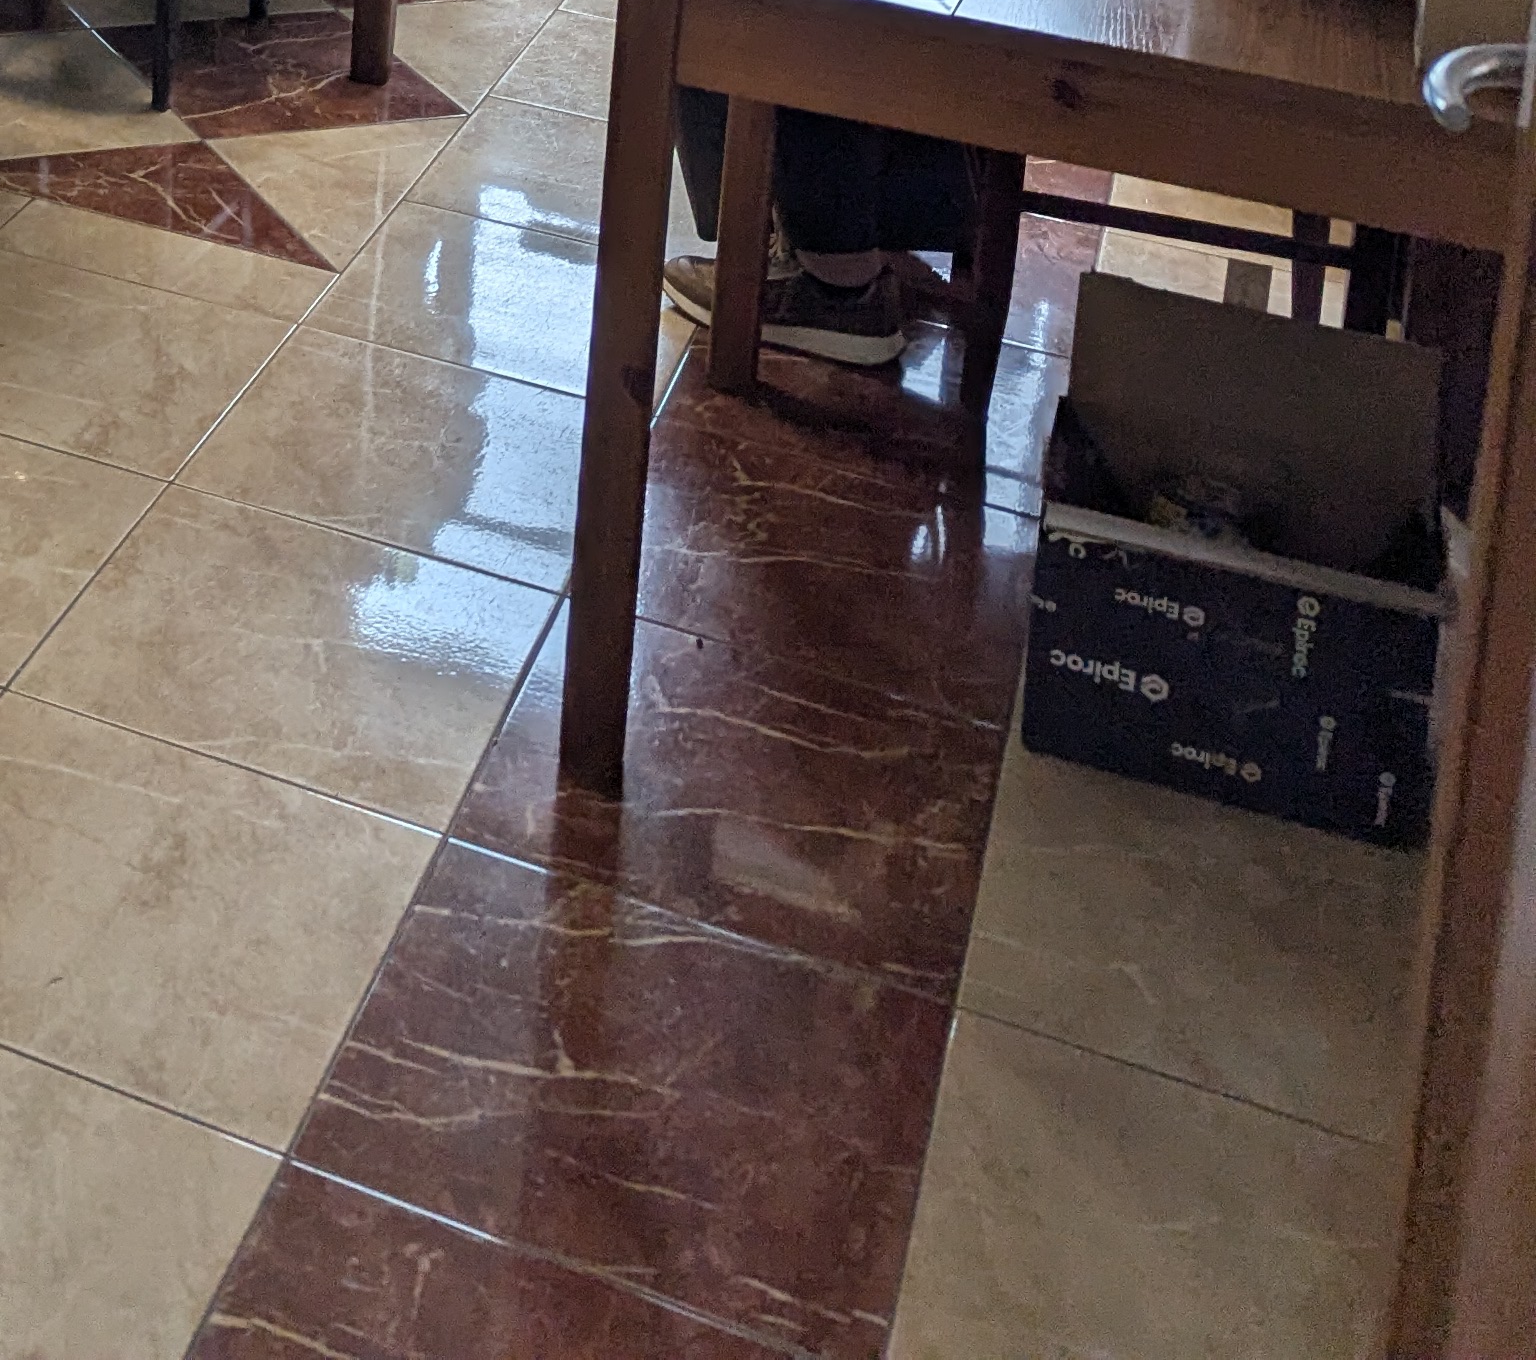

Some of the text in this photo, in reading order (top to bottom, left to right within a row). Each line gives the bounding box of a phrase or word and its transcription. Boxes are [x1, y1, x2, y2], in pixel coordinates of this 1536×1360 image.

[1114, 588, 1179, 620] Epiroc
[1291, 618, 1316, 678] Epiroc
[1050, 649, 1137, 692] Epiroc
